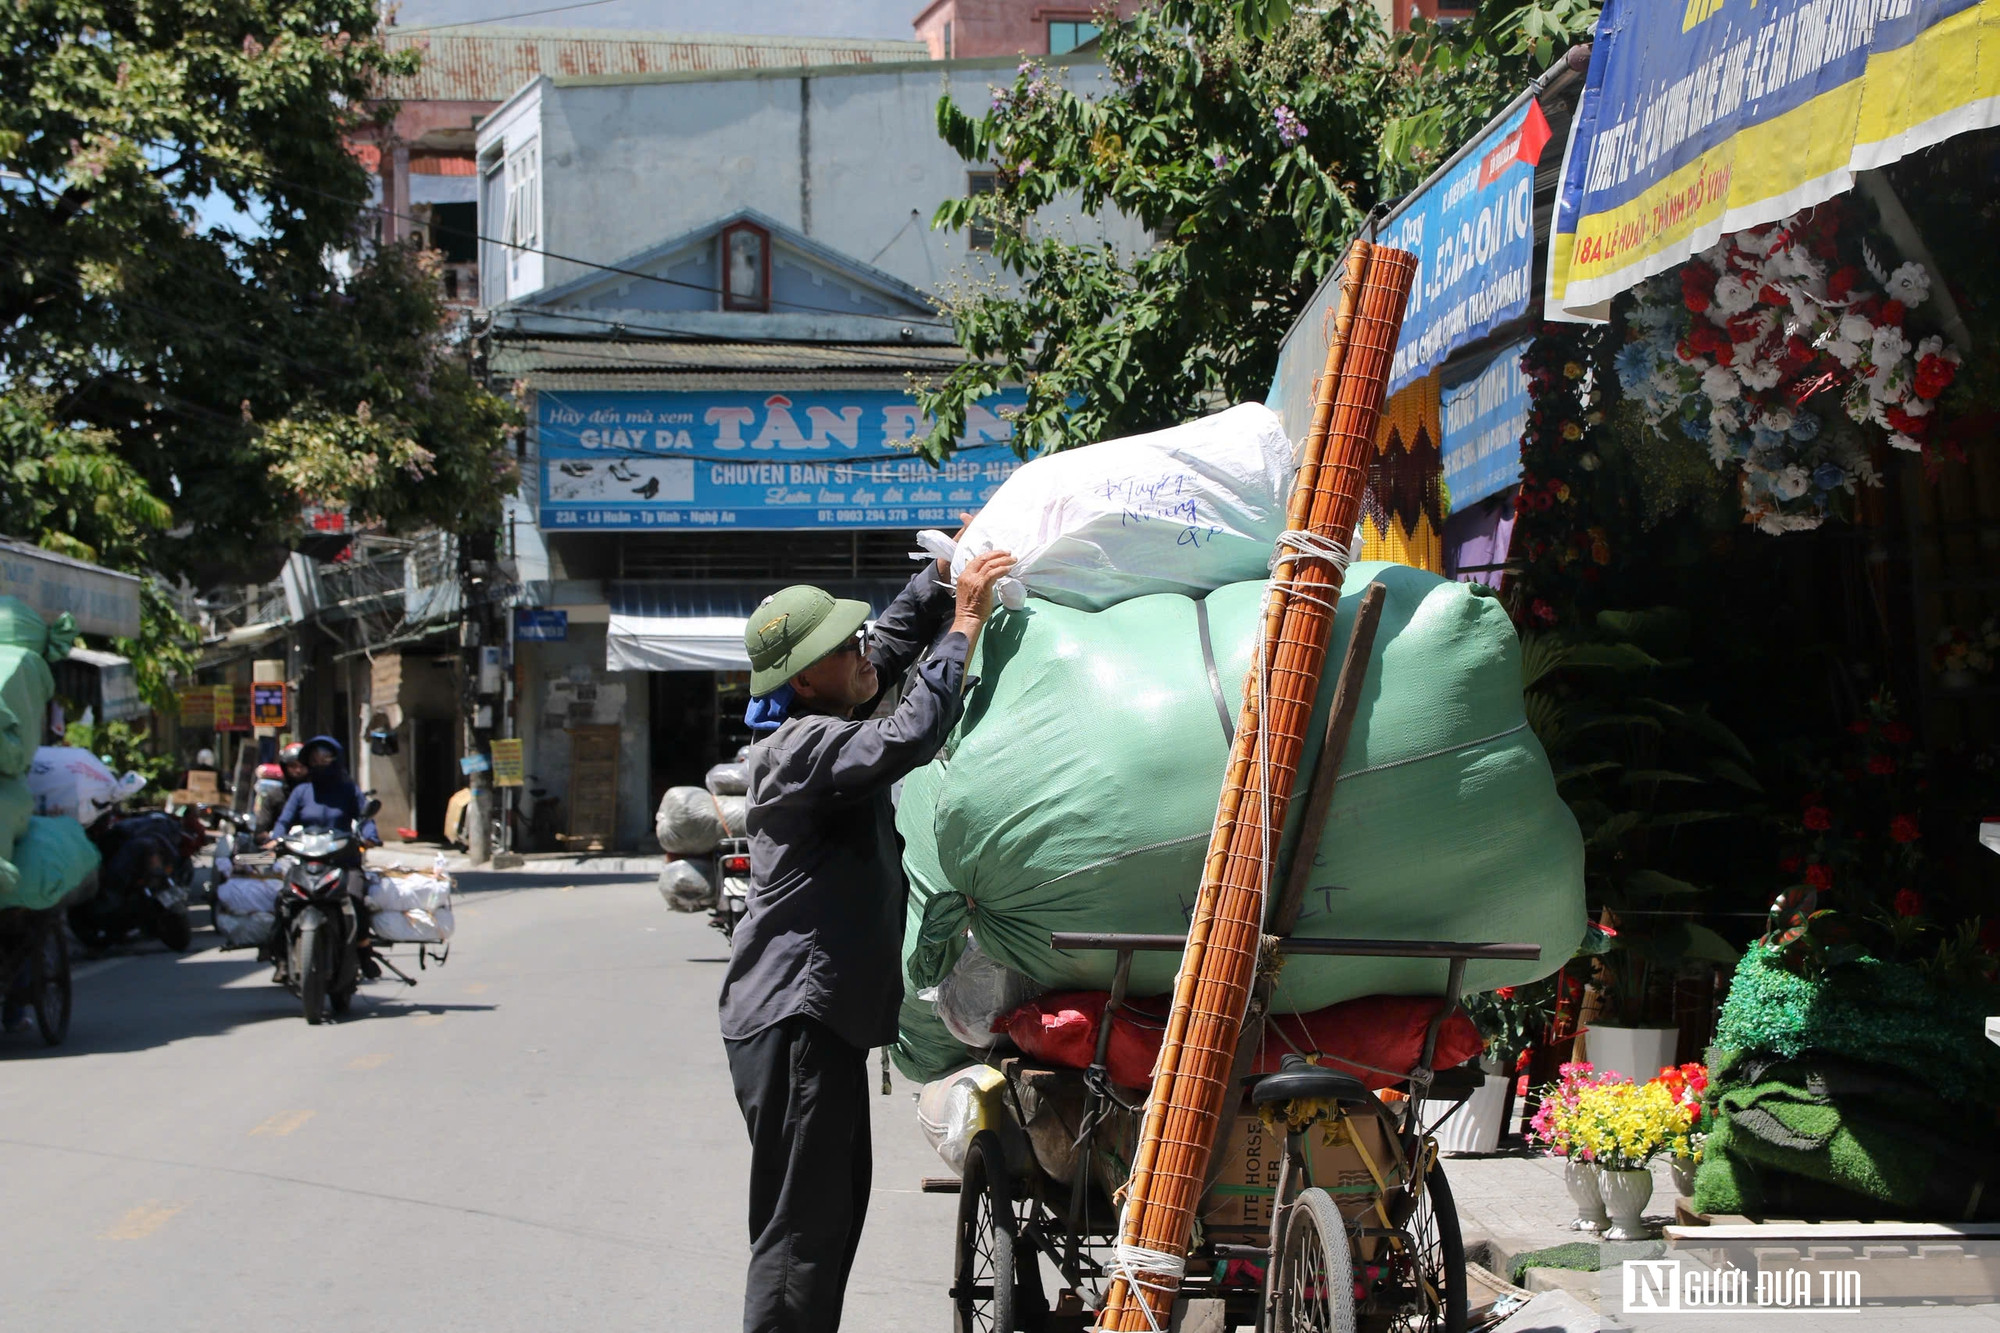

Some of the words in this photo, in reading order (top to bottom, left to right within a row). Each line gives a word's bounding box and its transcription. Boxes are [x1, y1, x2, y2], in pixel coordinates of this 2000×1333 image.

[1574, 236, 1602, 265] 18A
[1605, 222, 1619, 259] LÊ
[1653, 192, 1684, 238] THÀNH
[1708, 163, 1732, 204] VINH
[589, 407, 620, 423] đến
[626, 410, 653, 424] mà
[658, 413, 693, 424] xem
[705, 395, 862, 450] TÂN
[656, 430, 693, 449] DA
[556, 511, 577, 523] 23A
[657, 511, 680, 523] Vinh
[721, 511, 735, 522] An
[1246, 1123, 1261, 1185] HORSE
